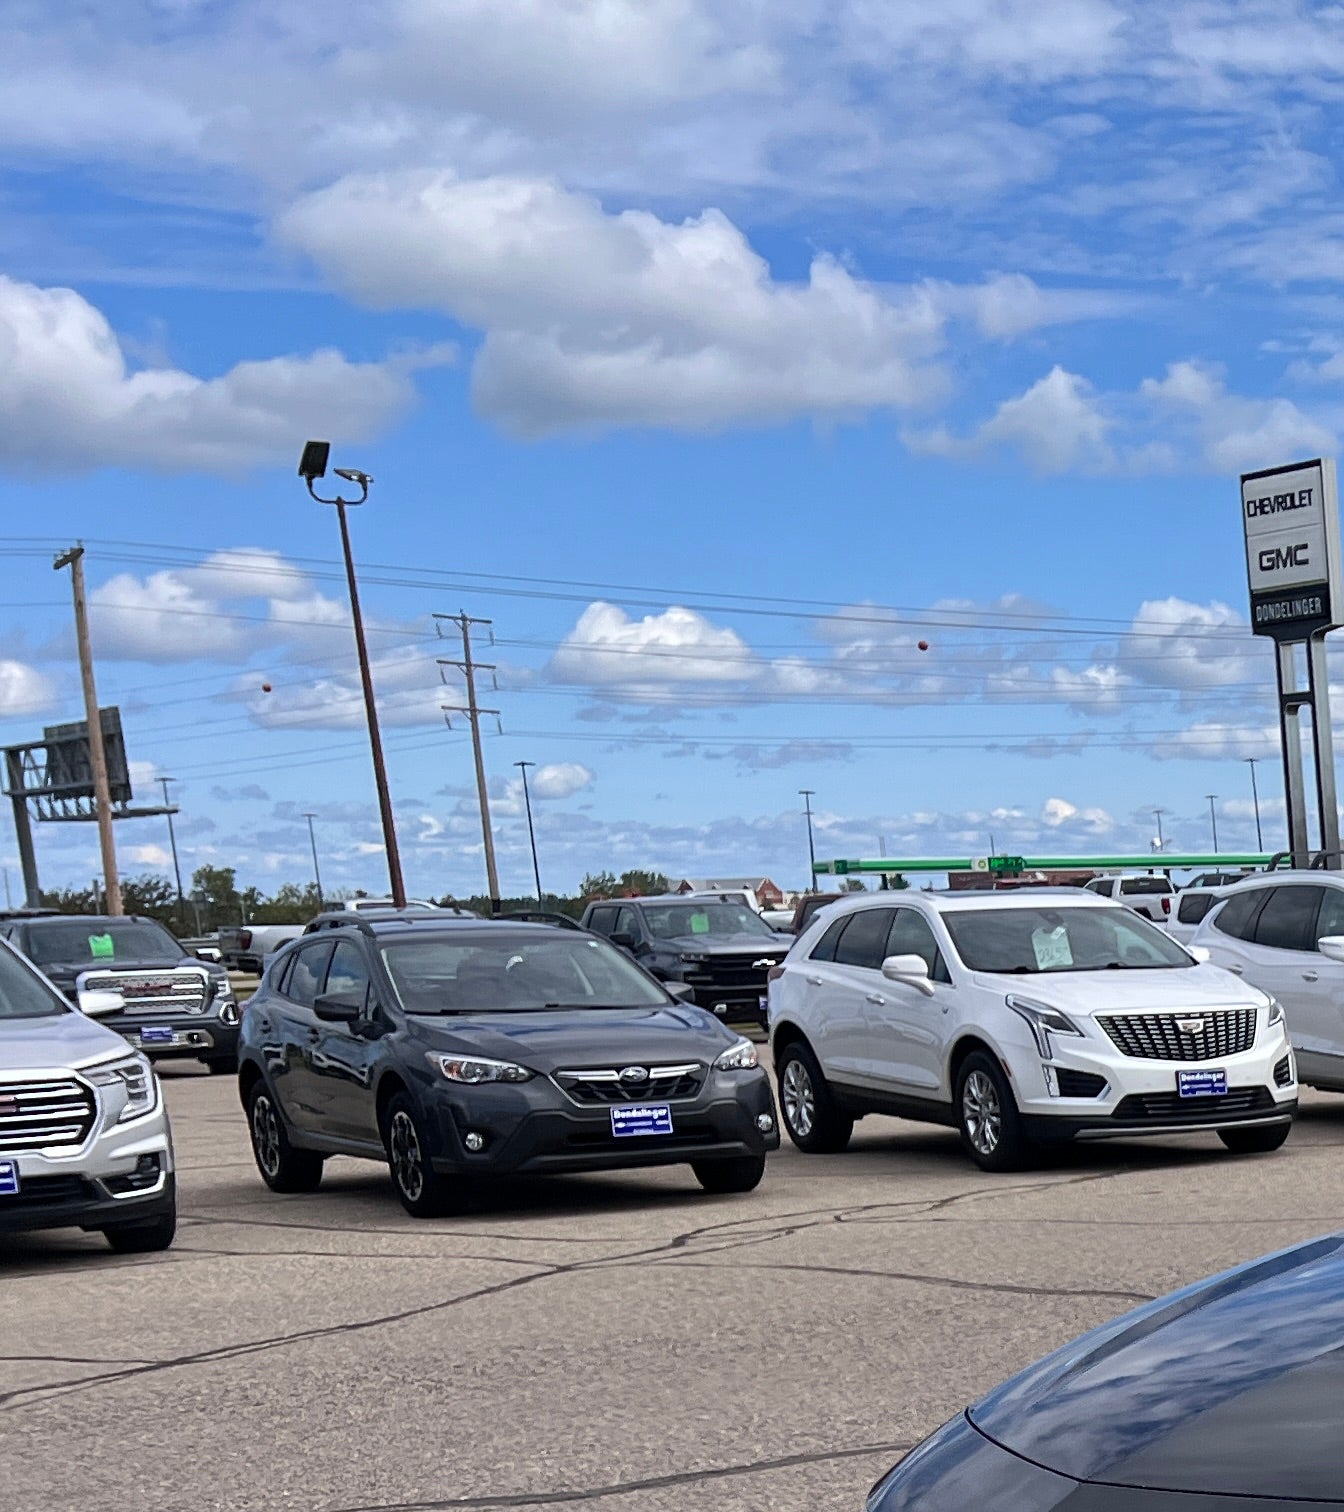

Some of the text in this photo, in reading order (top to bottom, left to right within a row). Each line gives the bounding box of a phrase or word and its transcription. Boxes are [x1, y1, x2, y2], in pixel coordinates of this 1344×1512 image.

[1246, 488, 1313, 518] CHEVROLET
[1259, 543, 1310, 572] GMC
[1256, 597, 1322, 622] DONDELINGER
